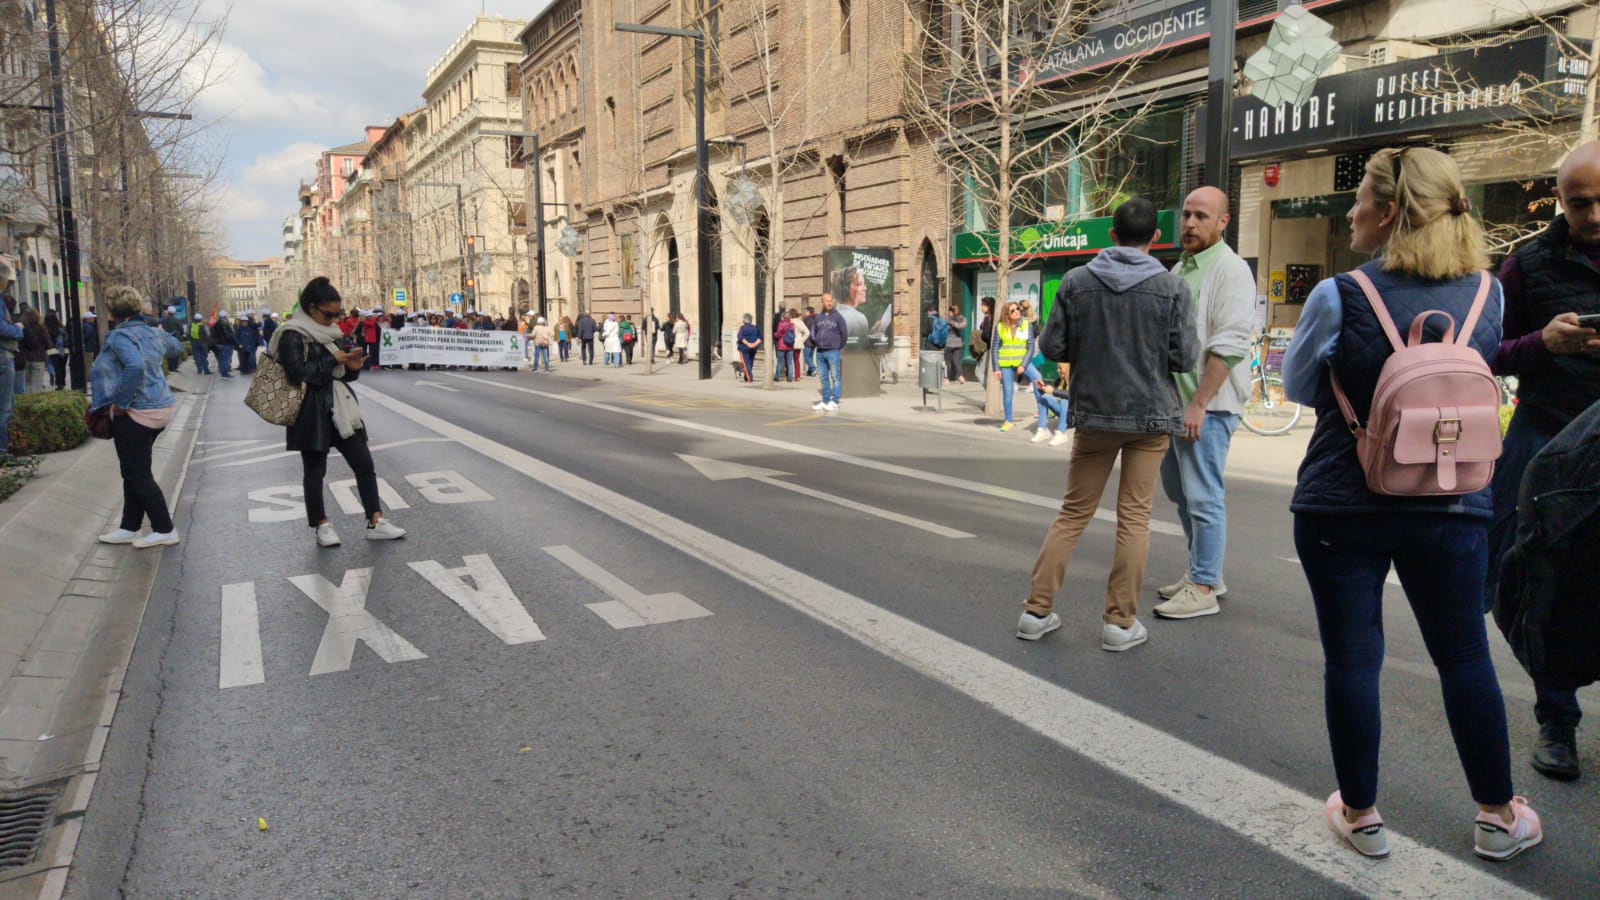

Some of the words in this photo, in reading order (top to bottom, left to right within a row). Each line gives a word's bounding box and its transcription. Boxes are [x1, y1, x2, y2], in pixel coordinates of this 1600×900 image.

[1038, 39, 1105, 73] CATALANA
[1113, 7, 1206, 50] OCCIDENTE
[1375, 82, 1521, 123] MEDITERRANEO
[1376, 68, 1441, 98] BUFFET
[1233, 92, 1336, 140] -HAMBRE
[1043, 228, 1088, 250] Unicaja
[247, 470, 496, 523] BUS
[219, 544, 715, 690] TAXI
